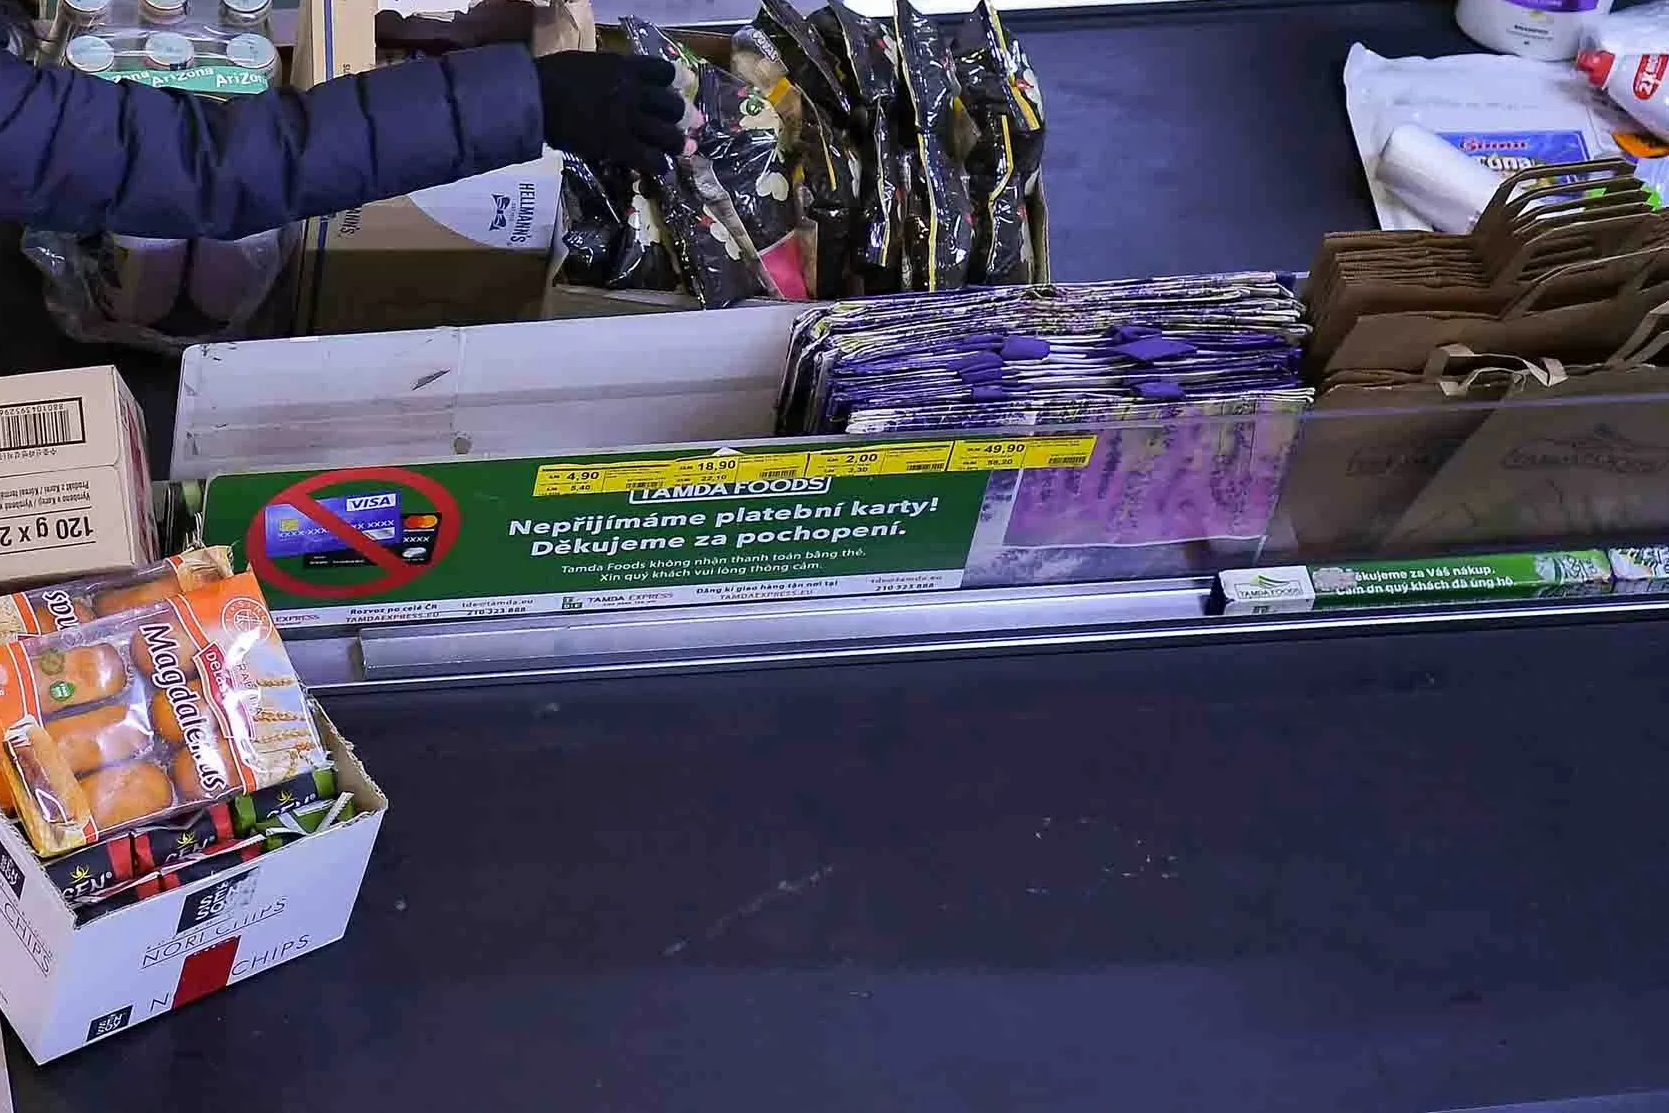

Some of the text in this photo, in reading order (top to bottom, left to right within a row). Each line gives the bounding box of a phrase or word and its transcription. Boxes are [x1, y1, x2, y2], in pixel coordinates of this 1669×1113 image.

[697, 460, 736, 472] 18,90
[566, 470, 600, 482] 4,90
[642, 477, 824, 499] TAMDA FOODS
[350, 496, 392, 510] VISA
[508, 497, 939, 537] Nepřijímáme platební karty!
[18, 526, 31, 543] x
[36, 517, 49, 539] g
[56, 516, 94, 540] 120
[531, 520, 907, 556] Děkujeme za pochopení.
[562, 565, 604, 574] Tamda
[607, 562, 646, 571] Foods
[649, 558, 691, 571] không
[730, 554, 769, 564] thanh
[773, 550, 803, 561] toán
[600, 573, 621, 582] Xin
[624, 571, 650, 582] quý
[652, 568, 690, 578] khách
[694, 567, 714, 576] vui
[1355, 571, 1408, 583] ěkujeme
[1426, 566, 1451, 577] Váš
[1453, 565, 1496, 577] nákup.
[1412, 579, 1450, 592] khách
[587, 596, 625, 604] TAMDA
[274, 614, 320, 623] EXPRESS
[350, 606, 384, 616] Rozvoz
[402, 604, 423, 613] celé
[3, 902, 52, 973] CHIPS
[142, 932, 205, 967] NORI
[231, 934, 311, 976] CHIPS
